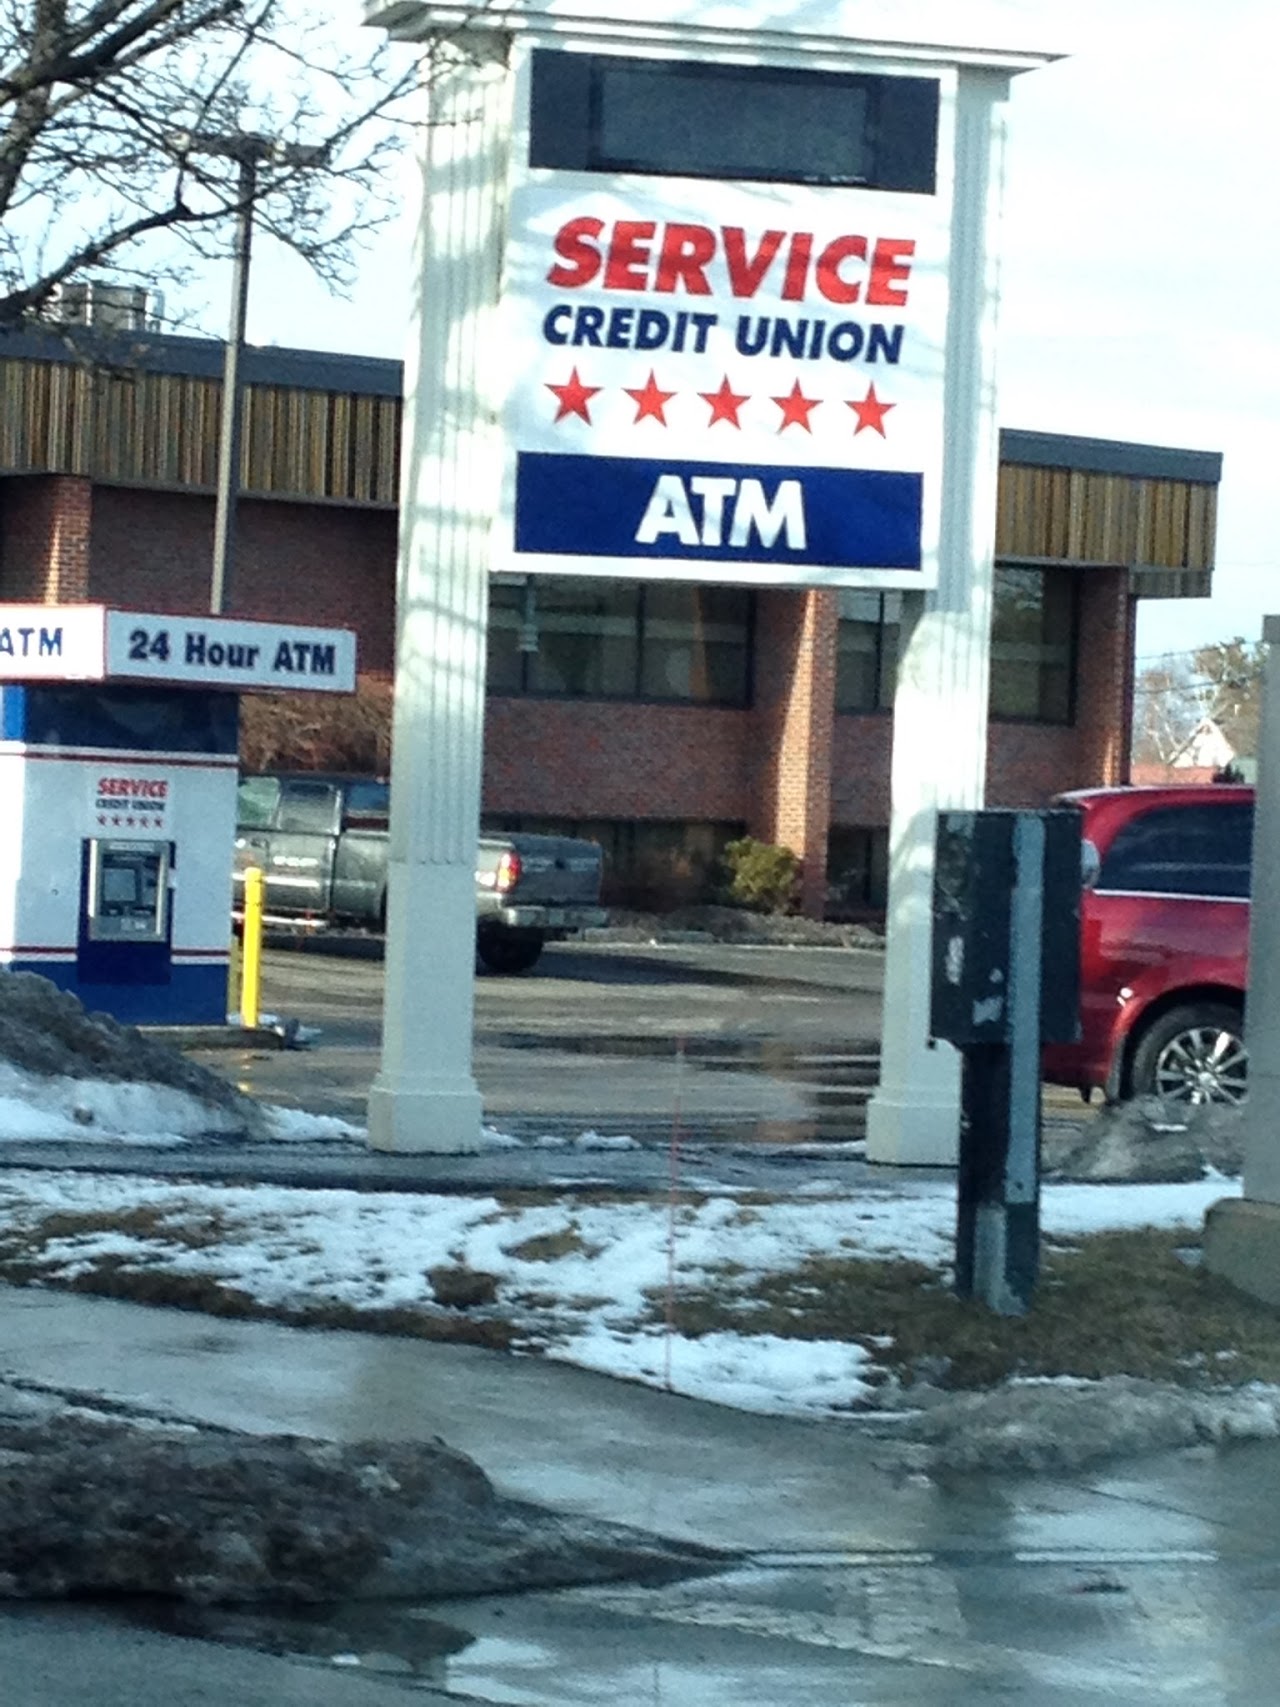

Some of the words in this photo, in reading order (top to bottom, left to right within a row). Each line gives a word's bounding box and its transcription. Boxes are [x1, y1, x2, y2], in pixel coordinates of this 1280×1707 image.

[547, 217, 916, 306] SERVICE
[543, 305, 718, 353] CREDIT
[735, 316, 905, 364] UNION
[634, 474, 807, 550] ATM
[0, 628, 63, 657] ATM
[129, 629, 170, 662] 24
[185, 633, 260, 669] Hour
[273, 642, 336, 675] ATM
[96, 778, 168, 797] SERVICE
